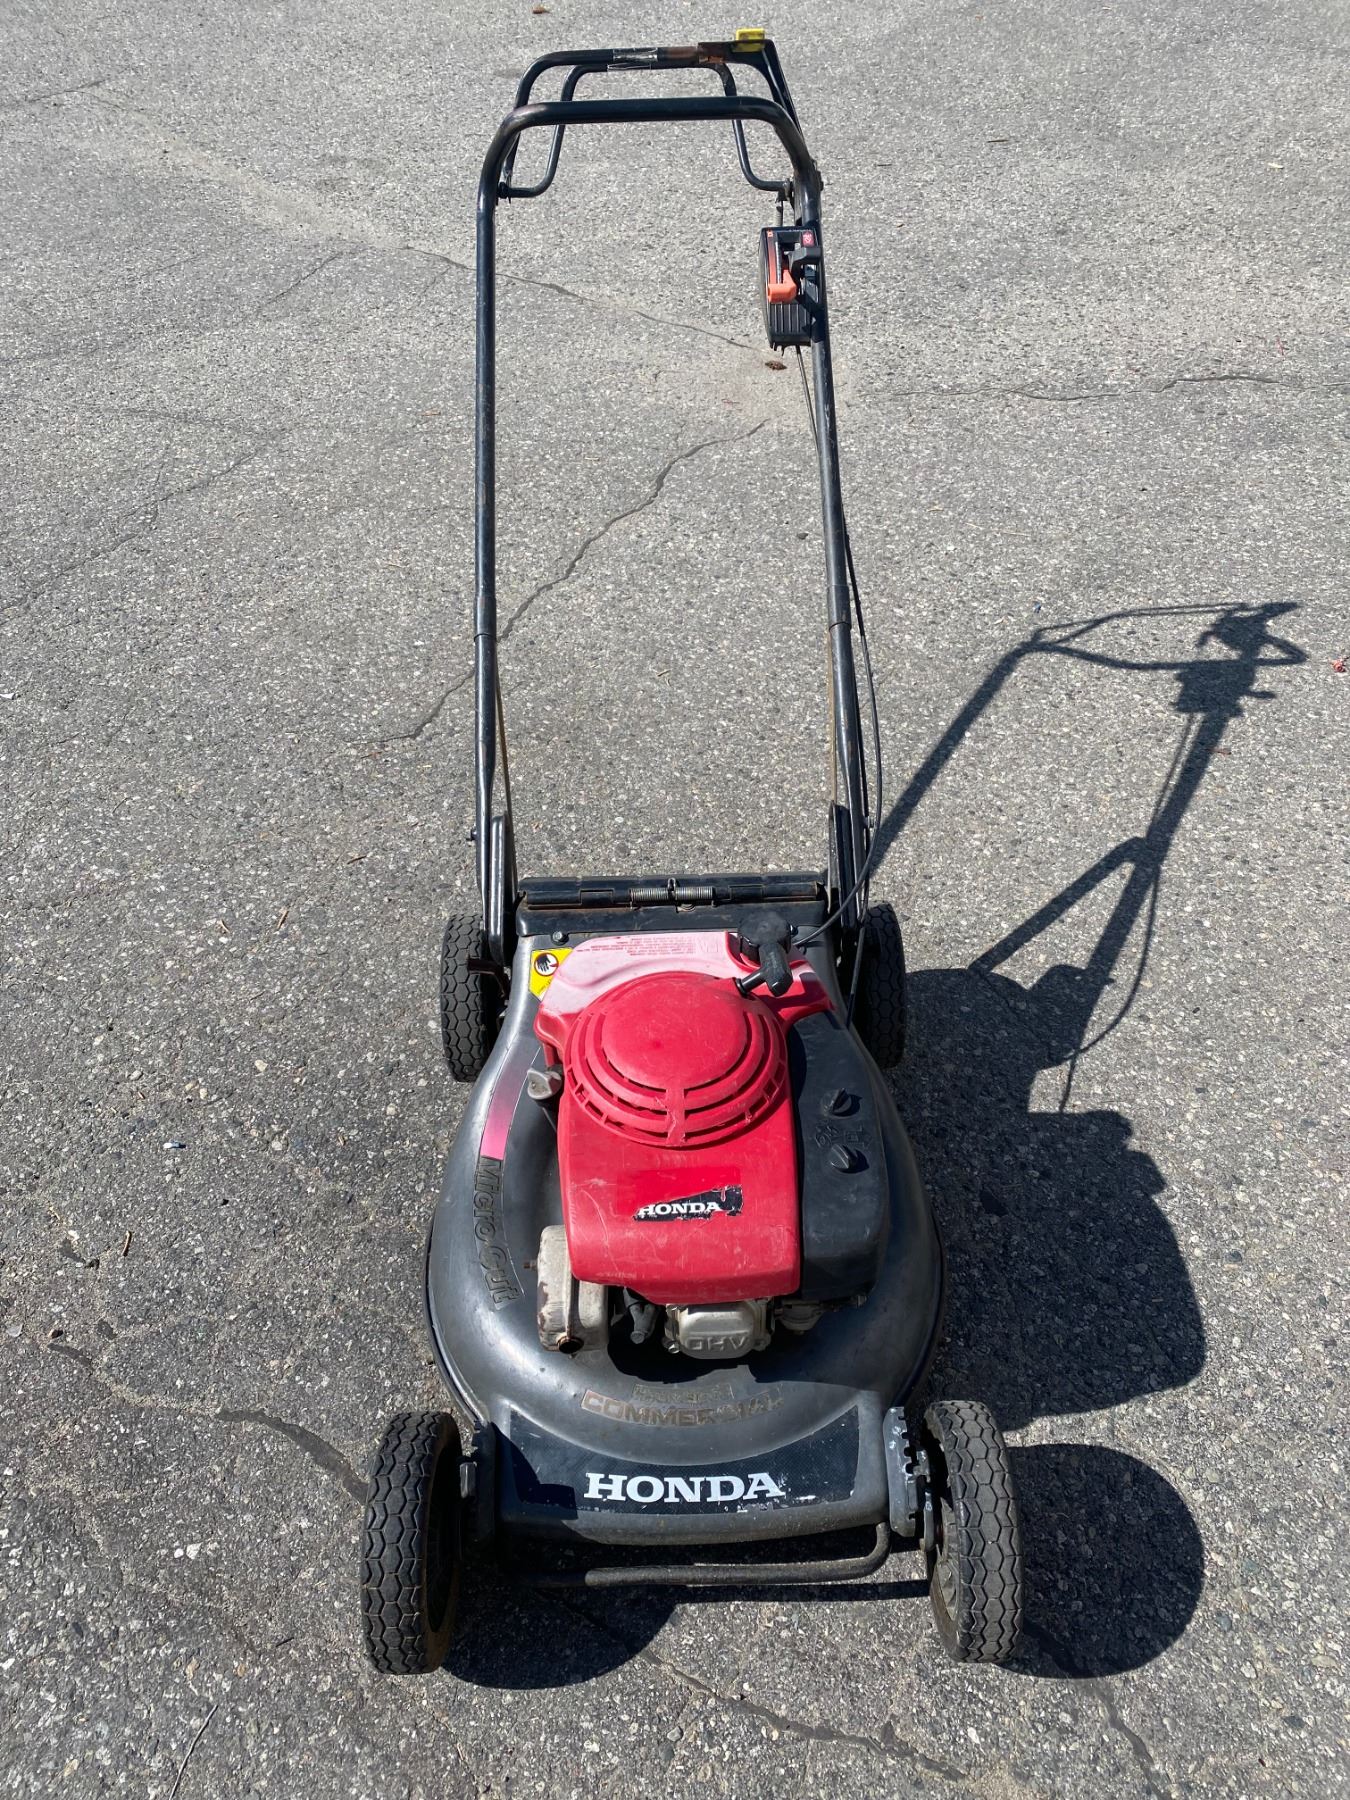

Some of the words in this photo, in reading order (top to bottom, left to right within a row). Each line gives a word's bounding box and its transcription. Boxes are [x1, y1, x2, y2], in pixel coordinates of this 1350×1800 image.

[637, 1201, 723, 1216] HONDA
[686, 1335, 747, 1352] OHV
[584, 1472, 786, 1503] HONDA
